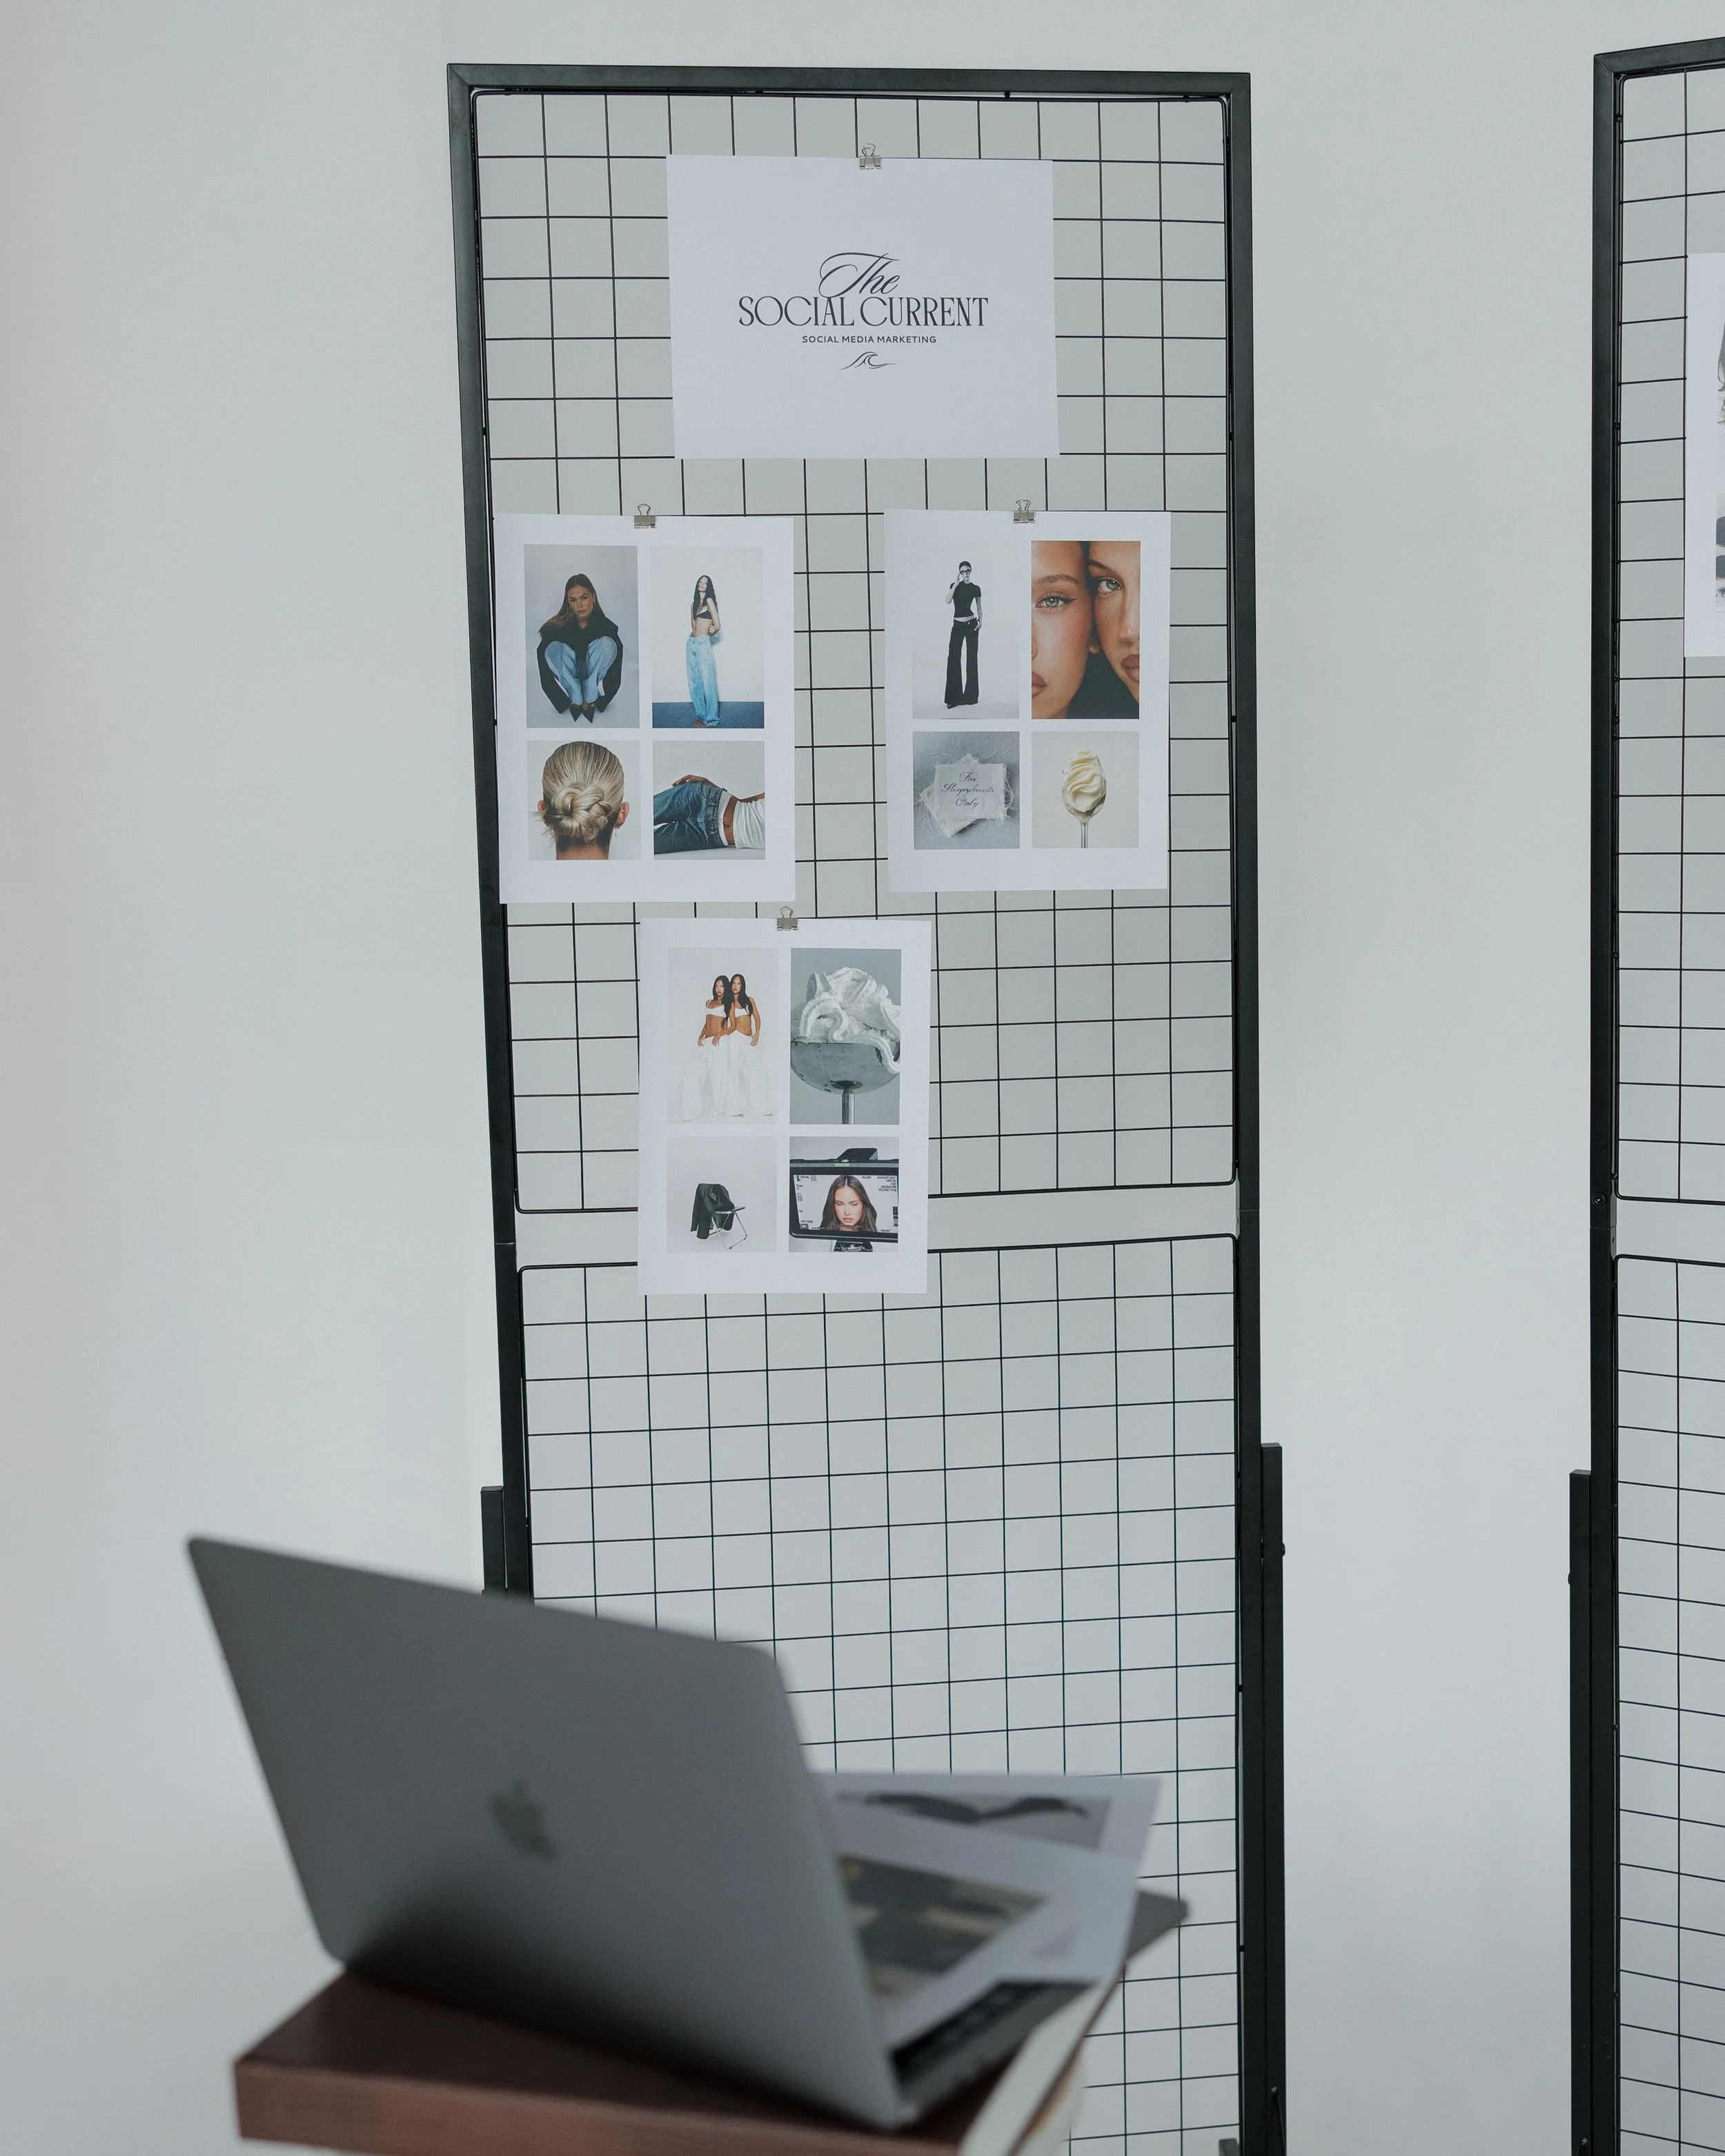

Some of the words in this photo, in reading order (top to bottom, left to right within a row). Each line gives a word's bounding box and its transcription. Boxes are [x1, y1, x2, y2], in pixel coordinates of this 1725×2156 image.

[818, 252, 900, 298] The
[738, 295, 855, 326] SOCIAL
[860, 296, 989, 326] CURRENT
[959, 771, 977, 782] For
[955, 796, 980, 809] Only
